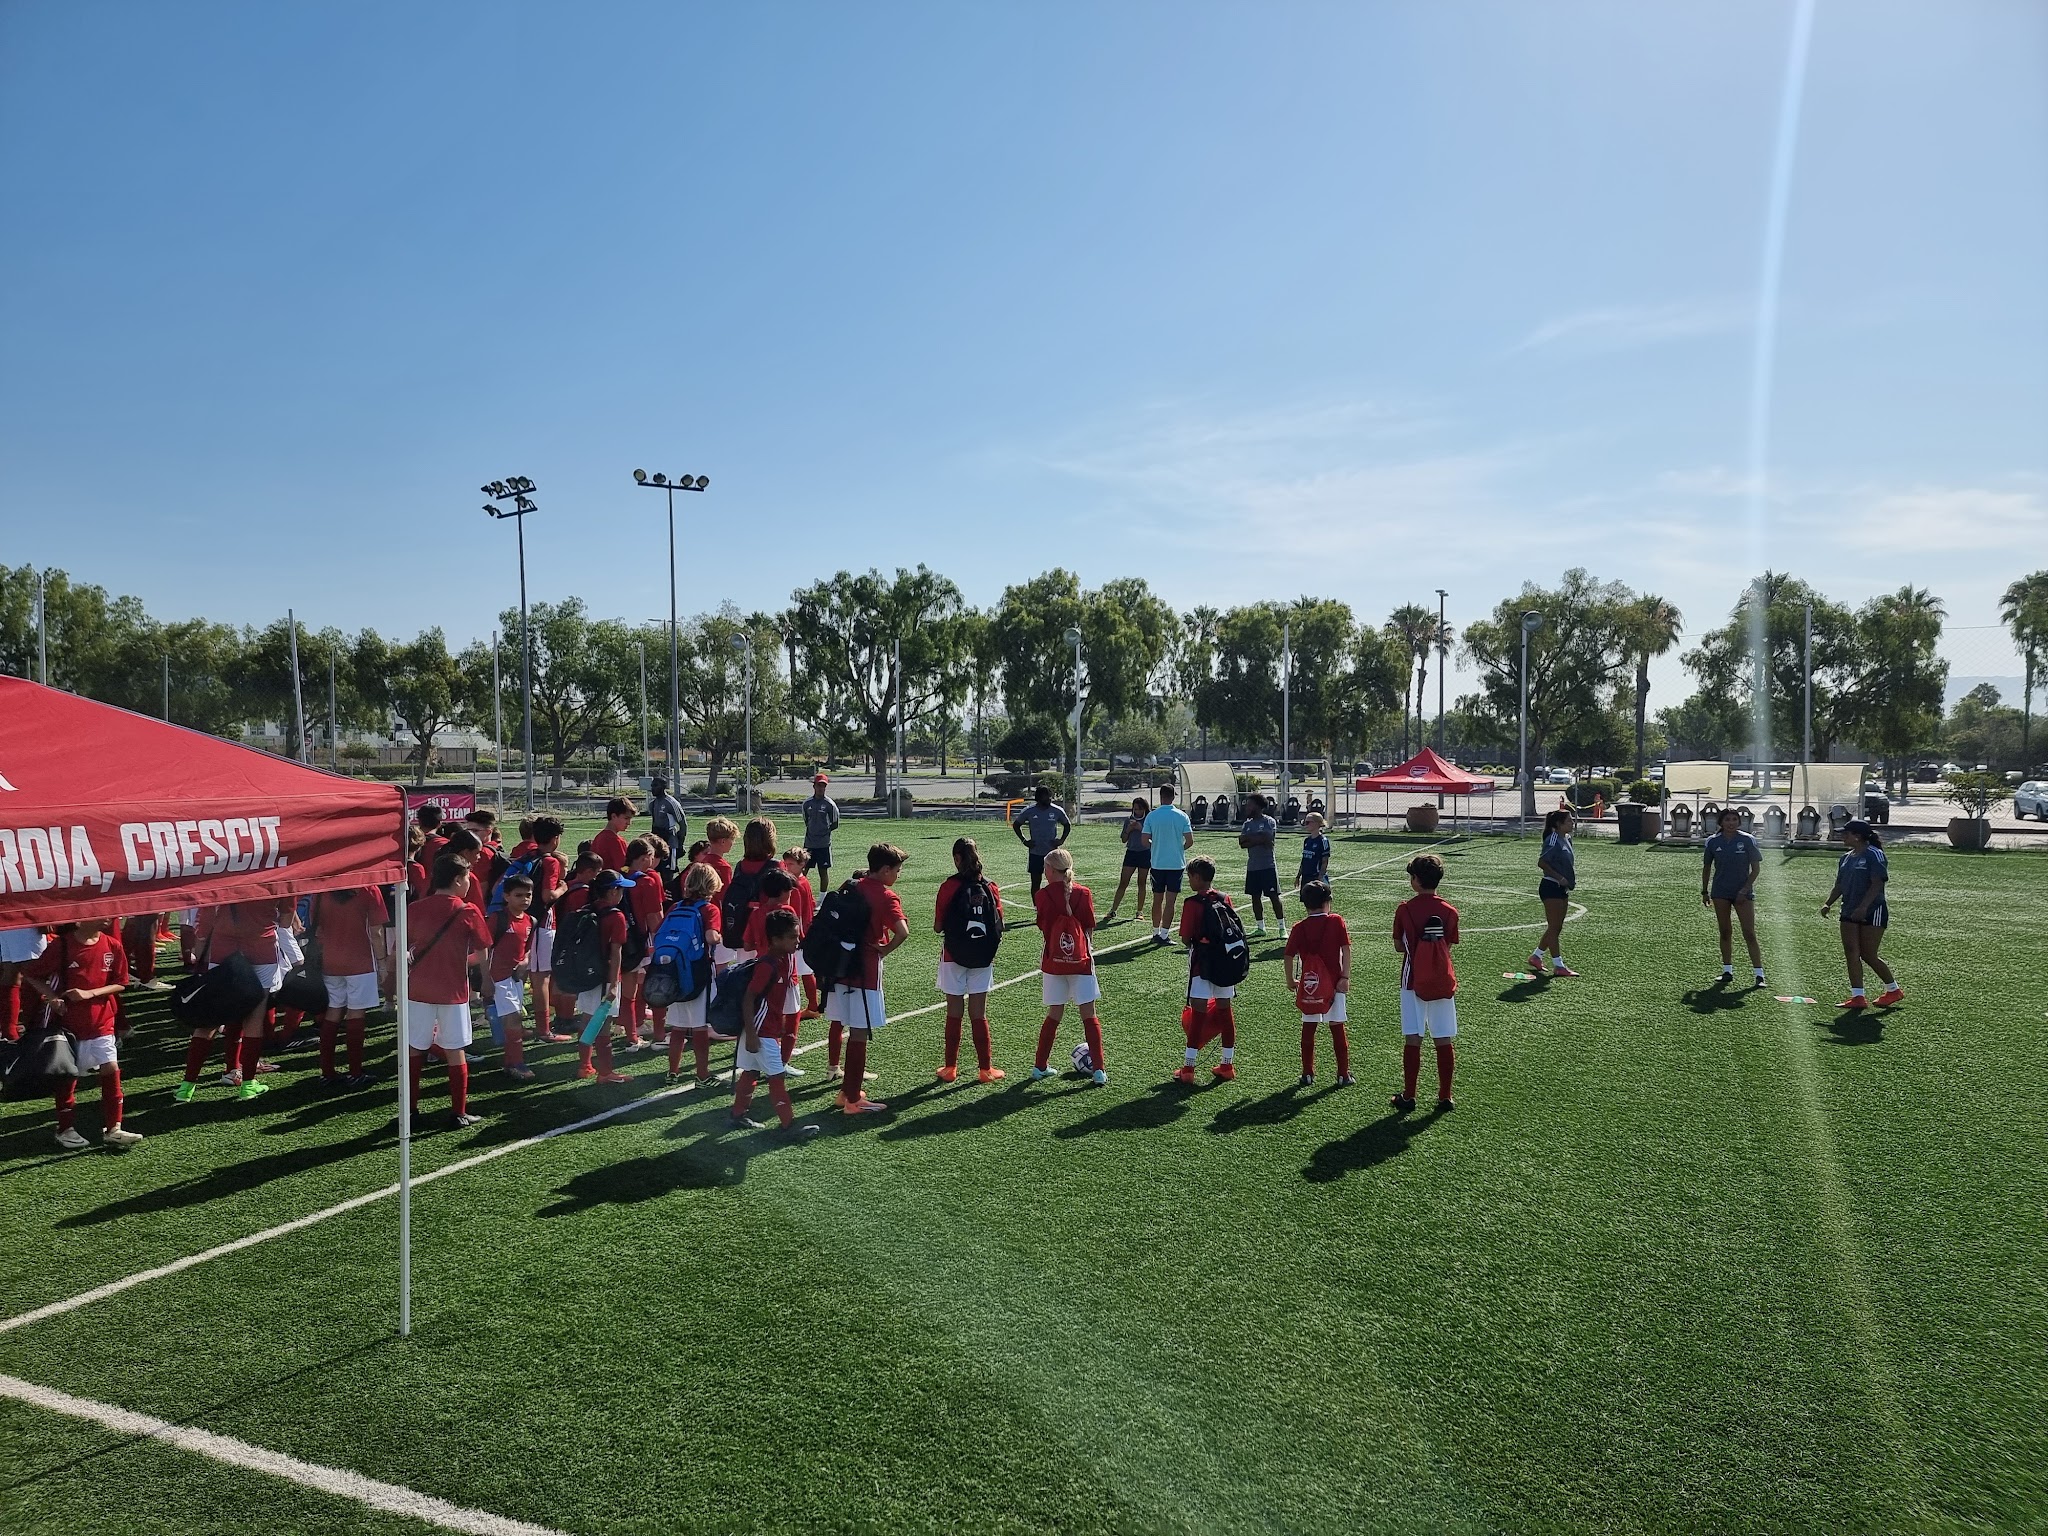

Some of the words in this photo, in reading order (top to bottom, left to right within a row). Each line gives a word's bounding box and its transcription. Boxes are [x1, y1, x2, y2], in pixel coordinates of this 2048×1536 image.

[440, 798, 450, 806] FC
[448, 808, 470, 820] TEAM
[120, 816, 288, 882] CRESCIT.
[972, 906, 982, 914] 10
[1226, 928, 1232, 936] 9
